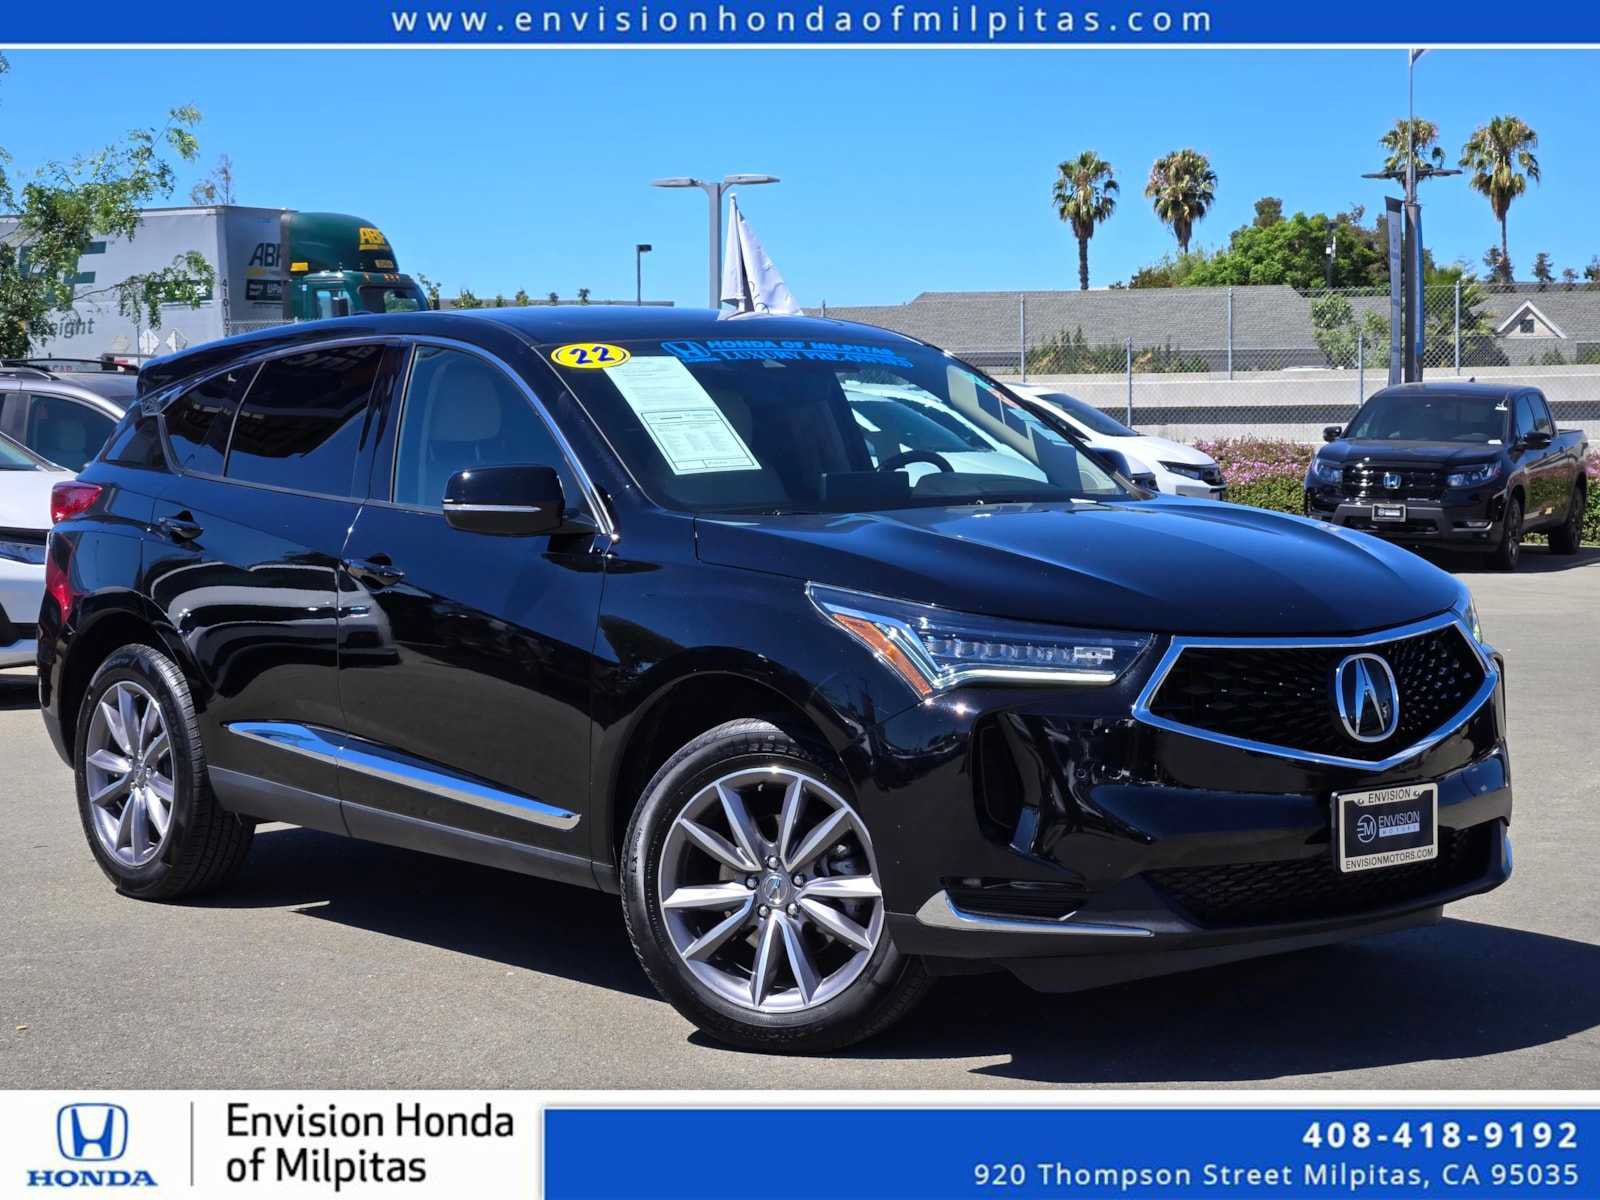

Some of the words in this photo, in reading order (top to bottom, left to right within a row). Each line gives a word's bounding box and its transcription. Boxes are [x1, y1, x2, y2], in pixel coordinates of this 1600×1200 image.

[706, 340, 779, 349] HONDA
[781, 341, 805, 349] OF
[569, 346, 616, 364] 22
[1369, 789, 1411, 804] ENVISION
[1378, 810, 1420, 828] ENVISION
[1346, 848, 1433, 869] ENVISIONMOTORS.COM
